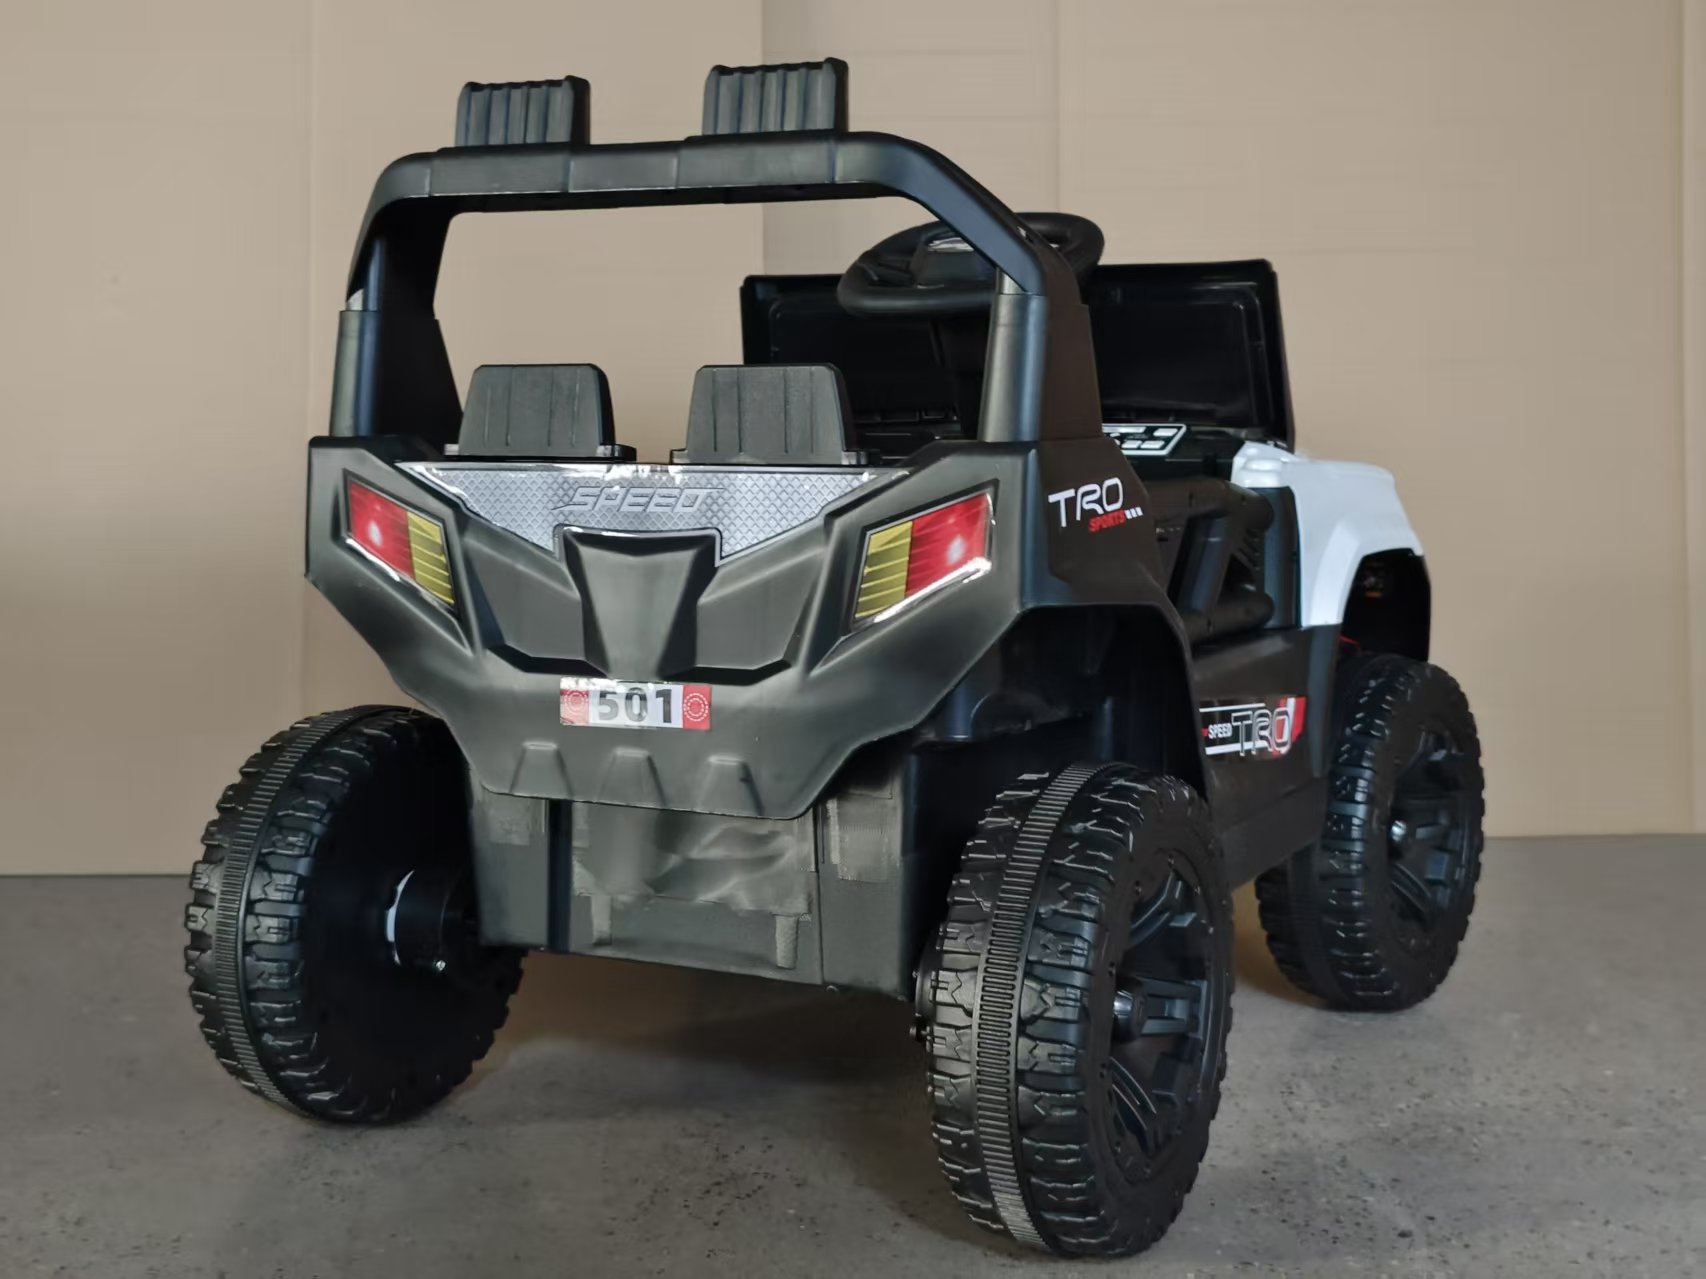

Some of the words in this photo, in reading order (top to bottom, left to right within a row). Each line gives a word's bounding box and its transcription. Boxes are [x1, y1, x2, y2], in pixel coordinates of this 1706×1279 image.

[552, 486, 724, 512] SPEED
[598, 686, 672, 724] 501
[1208, 722, 1232, 739] SPEED
